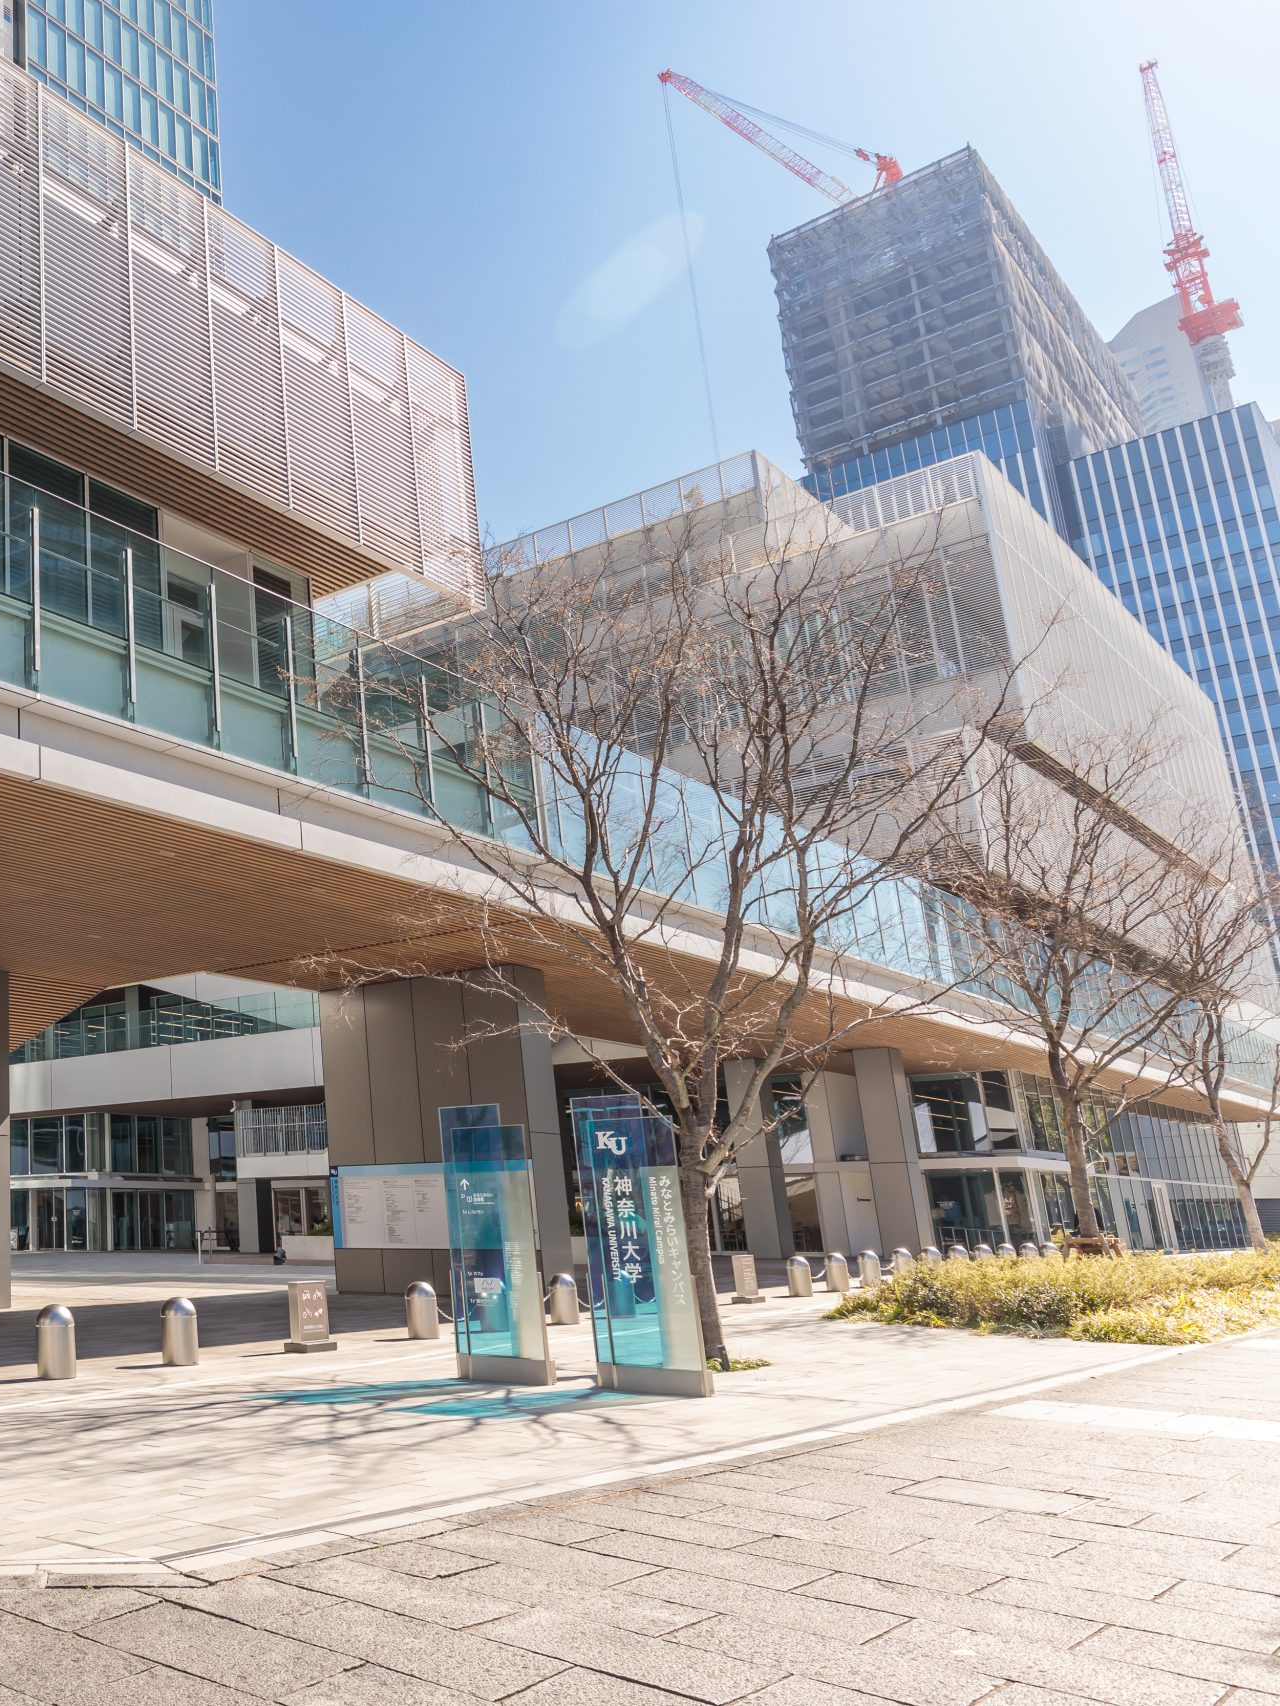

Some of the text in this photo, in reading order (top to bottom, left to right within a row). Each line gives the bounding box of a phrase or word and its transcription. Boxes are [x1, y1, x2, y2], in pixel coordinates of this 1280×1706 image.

[595, 1131, 627, 1155] KU
[601, 1177, 622, 1281] KANAGAWA UNIVERSITY
[614, 1175, 642, 1284] 神奈川大学
[648, 1176, 664, 1264] Minato Mirai Campus
[658, 1175, 686, 1305] みなとみらいキャンパス
